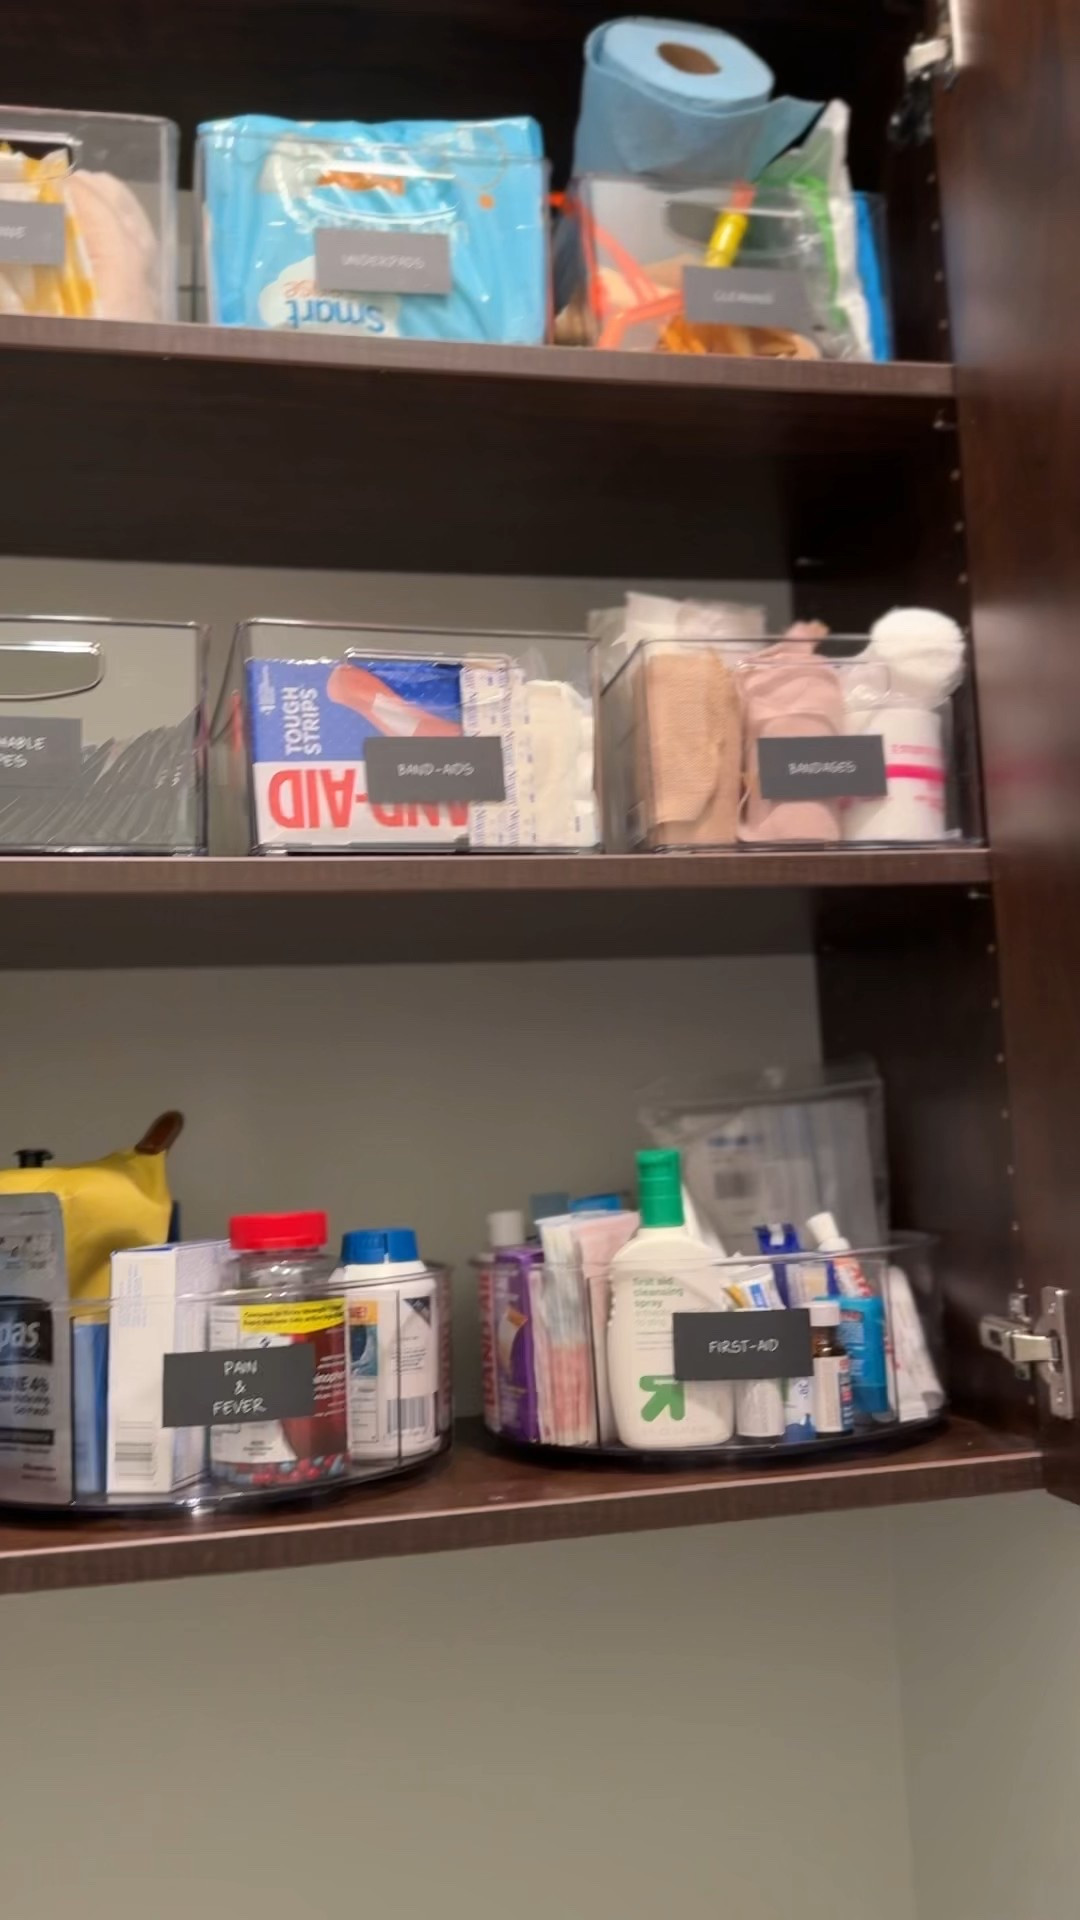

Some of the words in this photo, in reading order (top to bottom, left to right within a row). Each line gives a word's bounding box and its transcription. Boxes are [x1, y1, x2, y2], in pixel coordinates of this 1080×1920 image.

[286, 299, 385, 332] Smart
[281, 687, 302, 756] TOUGH
[300, 687, 322, 755] STRIPS
[396, 762, 475, 777] BAND-AIDS
[787, 760, 857, 775] BANDAGES
[708, 1338, 780, 1354] FIRST-AID
[223, 1360, 258, 1376] PAIN
[234, 1380, 247, 1395] &
[212, 1397, 268, 1416] FEVER
